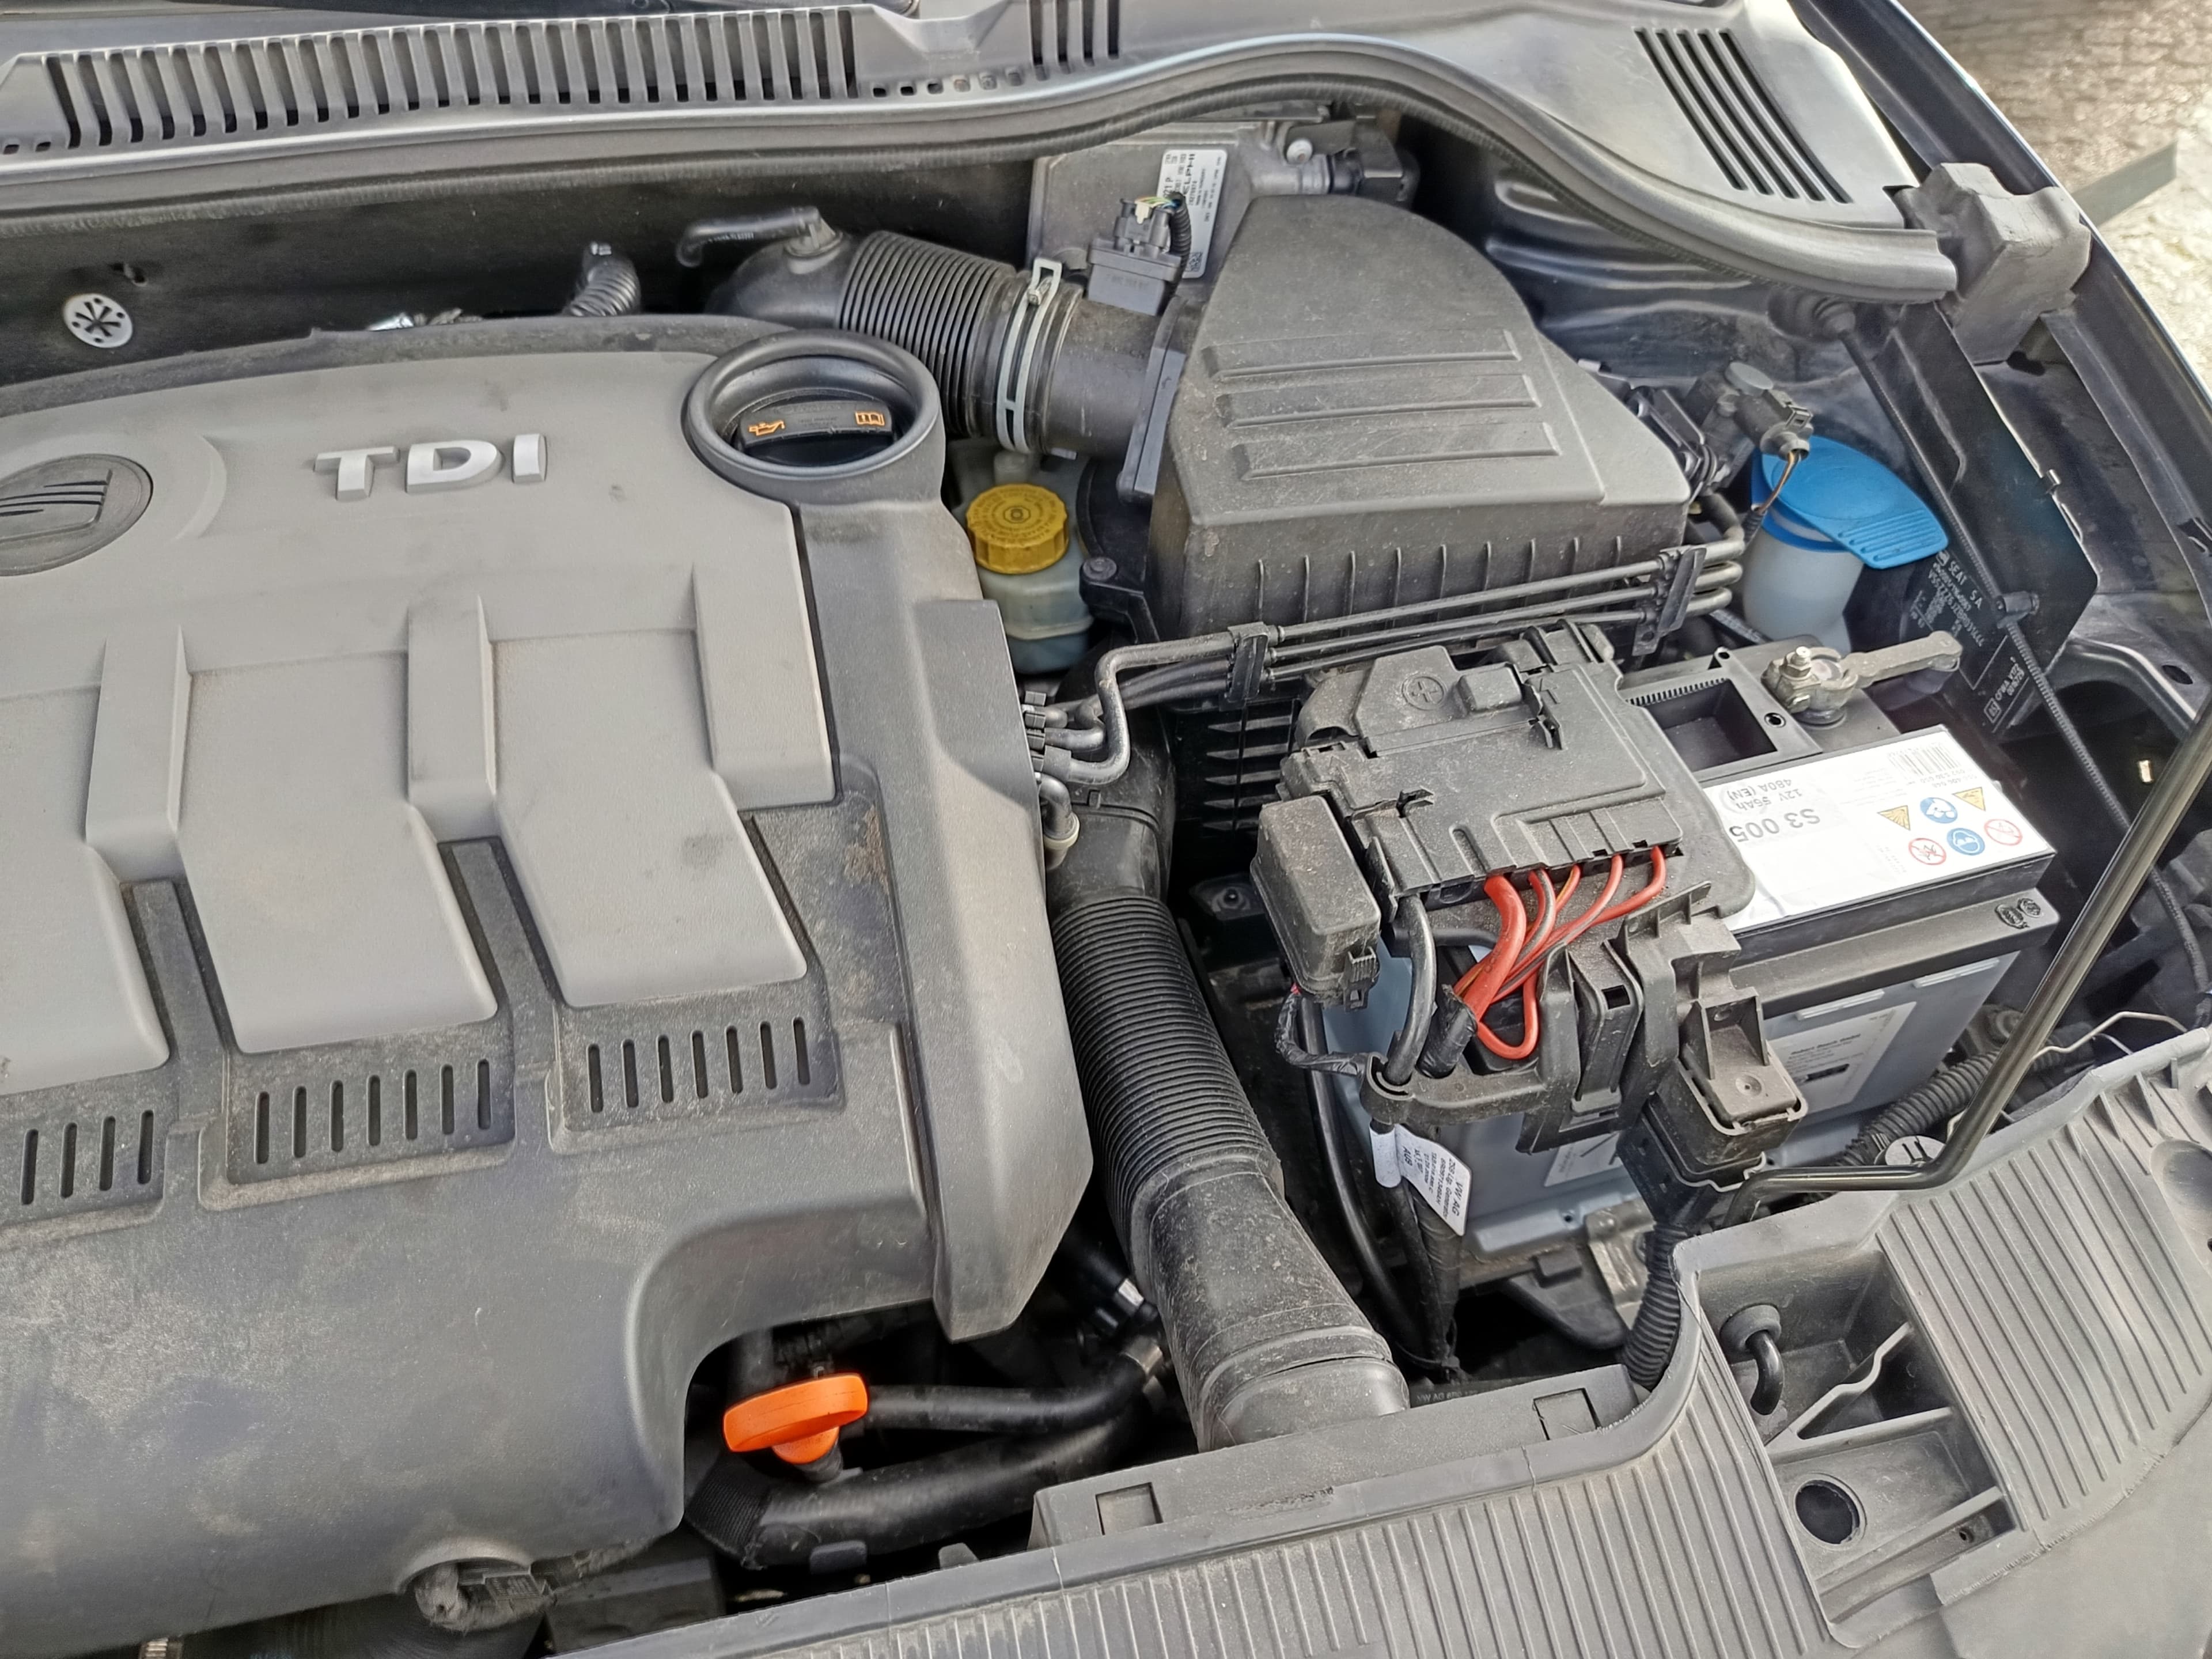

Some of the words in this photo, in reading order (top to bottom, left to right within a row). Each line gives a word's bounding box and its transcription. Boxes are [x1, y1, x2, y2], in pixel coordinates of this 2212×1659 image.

[1183, 153, 1195, 195] ELPHI
[313, 433, 548, 502] TDI
[1948, 560, 1967, 586] SEAT
[1726, 785, 1756, 801] (EN)
[1757, 779, 1792, 793] 480A
[1778, 788, 1802, 802] 12V
[1735, 796, 1772, 811] 56Ah
[1783, 808, 1821, 828] S3
[1728, 817, 1780, 843] 005
[1454, 1181, 1463, 1202] VW
[1452, 1202, 1460, 1217] AG
[1416, 1393, 1431, 1402] VW
[1433, 1392, 1445, 1401] AG
